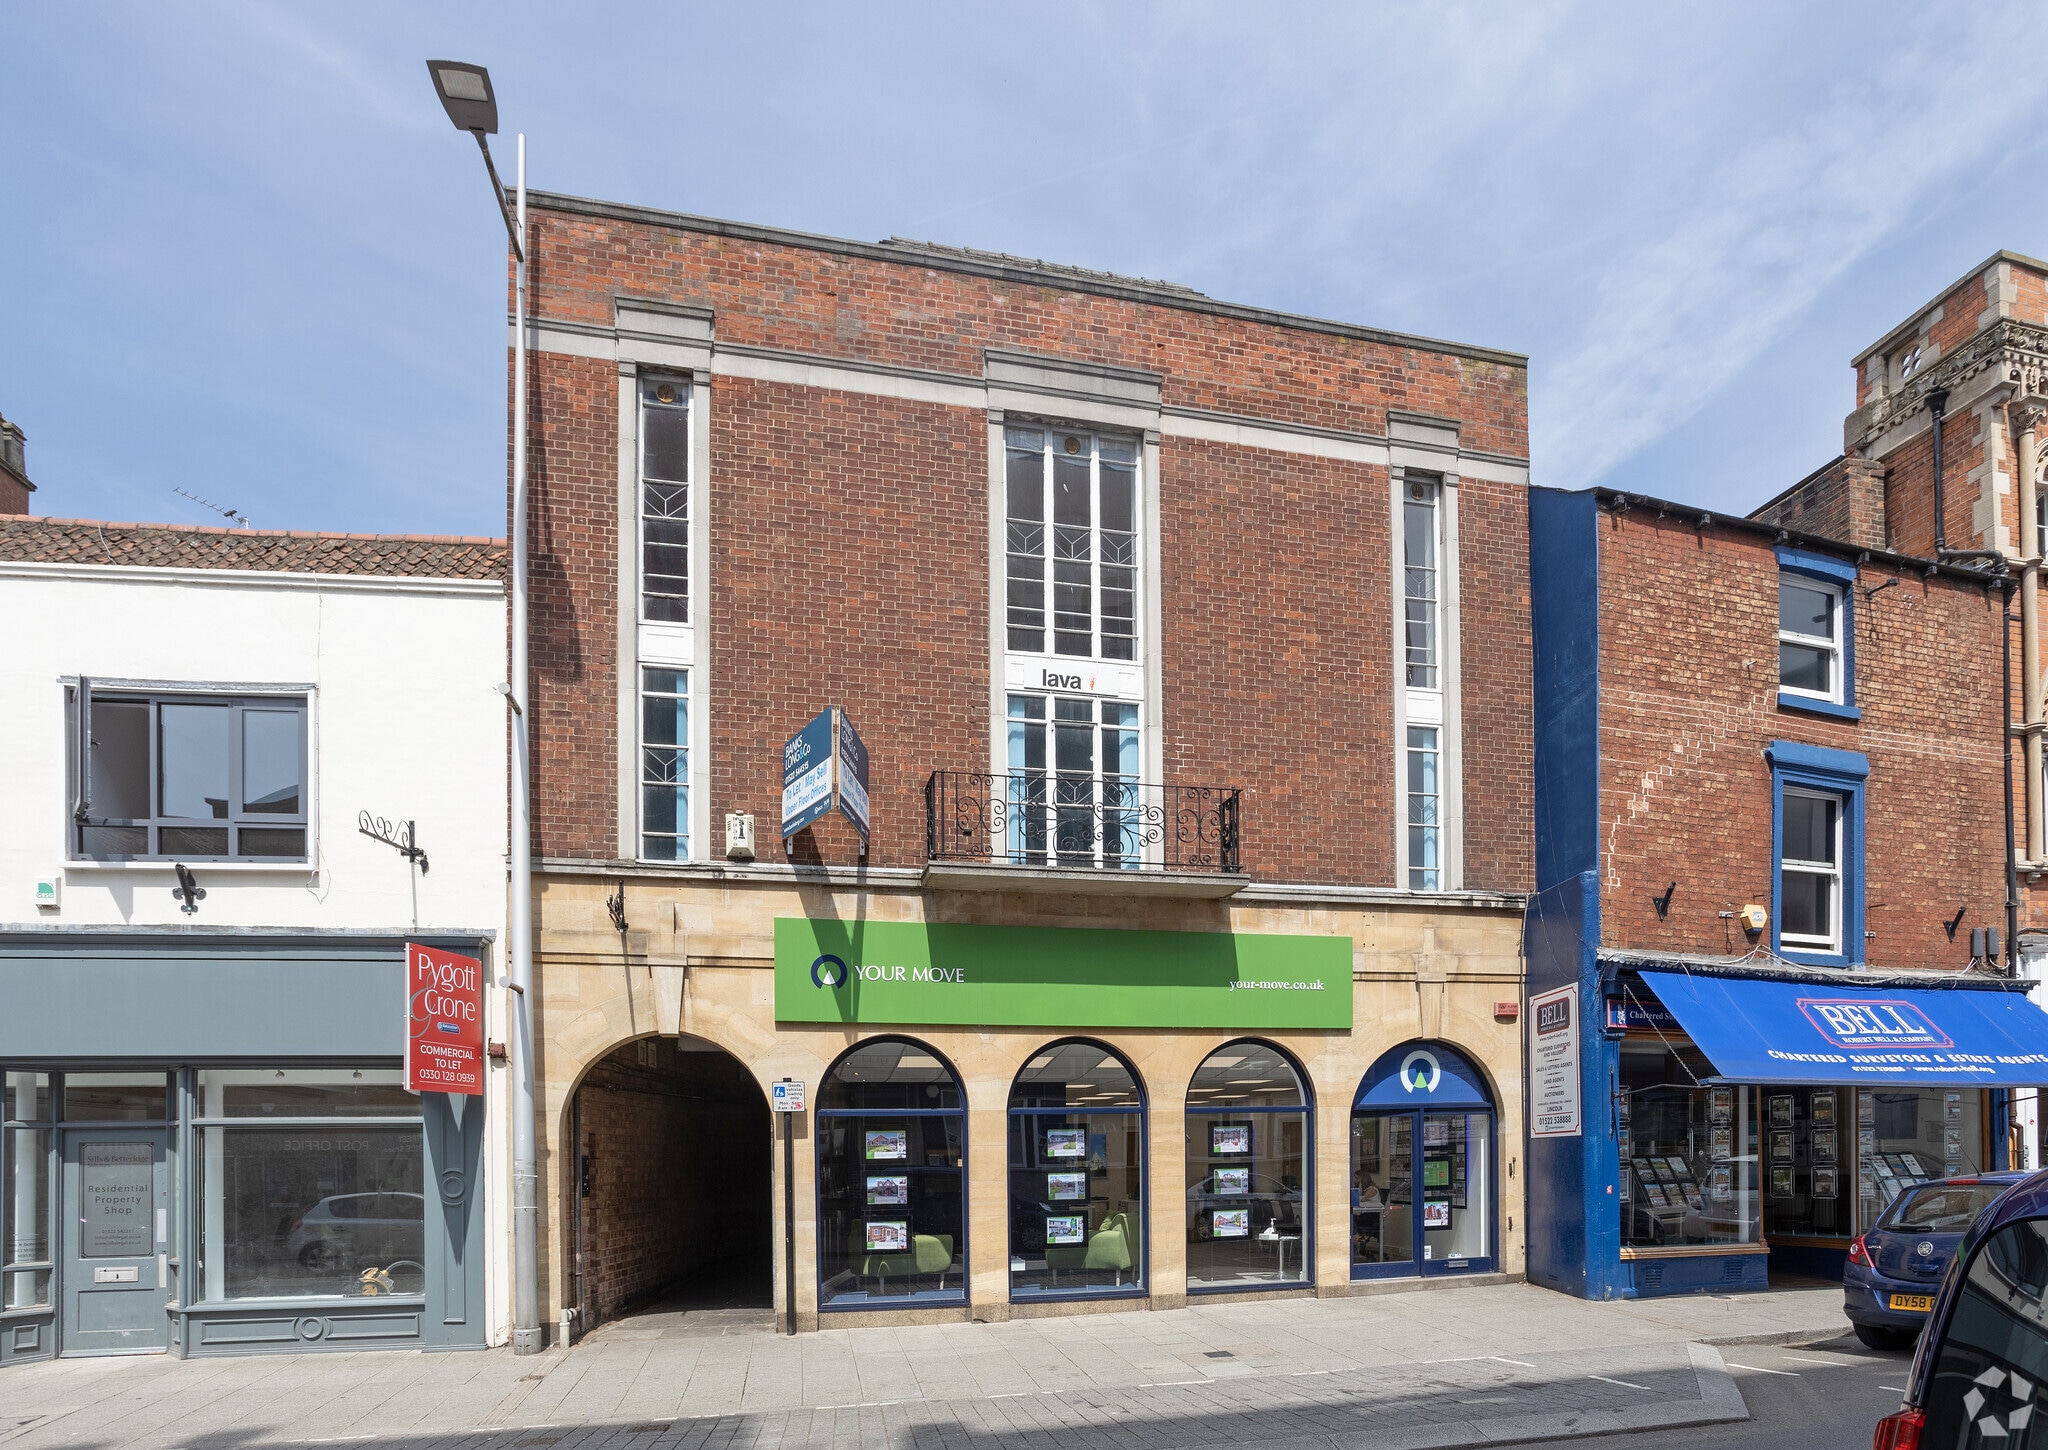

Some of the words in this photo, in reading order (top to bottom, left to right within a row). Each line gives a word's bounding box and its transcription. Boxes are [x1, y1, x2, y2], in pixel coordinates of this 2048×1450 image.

[1042, 669, 1082, 689] lava
[785, 734, 803, 759] BANKS
[785, 743, 811, 771] LONG&Co
[786, 788, 792, 801] To
[792, 781, 801, 797] Let
[805, 774, 815, 788] May
[817, 761, 828, 780] Sell
[785, 802, 798, 817] Upper
[798, 793, 810, 808] Floor
[811, 782, 827, 800] Offices
[418, 952, 476, 993] Pygott
[855, 965, 907, 982] YOUR
[912, 966, 965, 983] MOVE
[1229, 979, 1325, 992] your-move.co.uk
[424, 989, 476, 1022] Crone
[1541, 1002, 1566, 1026] BELL
[1629, 1010, 1663, 1020] Chartered
[1812, 1004, 1927, 1035] BELL
[420, 1044, 475, 1061] COMMERCIAL
[1767, 1049, 1847, 1063] CHARTERED
[1849, 1054, 1932, 1063] SURVEYORS
[1933, 1054, 1947, 1063] &
[1947, 1053, 1997, 1064] ESTATE
[1996, 1053, 2048, 1065] AGENTS
[435, 1058, 446, 1069] TO
[448, 1060, 462, 1071] LET
[419, 1068, 441, 1080] 0330
[442, 1070, 456, 1082] 128
[456, 1072, 476, 1084] 0939
[1544, 1090, 1565, 1098] AUCTIONEERS
[1539, 1116, 1554, 1125] 01522
[88, 1184, 148, 1193] Residential
[95, 1195, 142, 1205] Property
[104, 1206, 132, 1215] Shop
[1895, 1295, 1926, 1308] DY58
